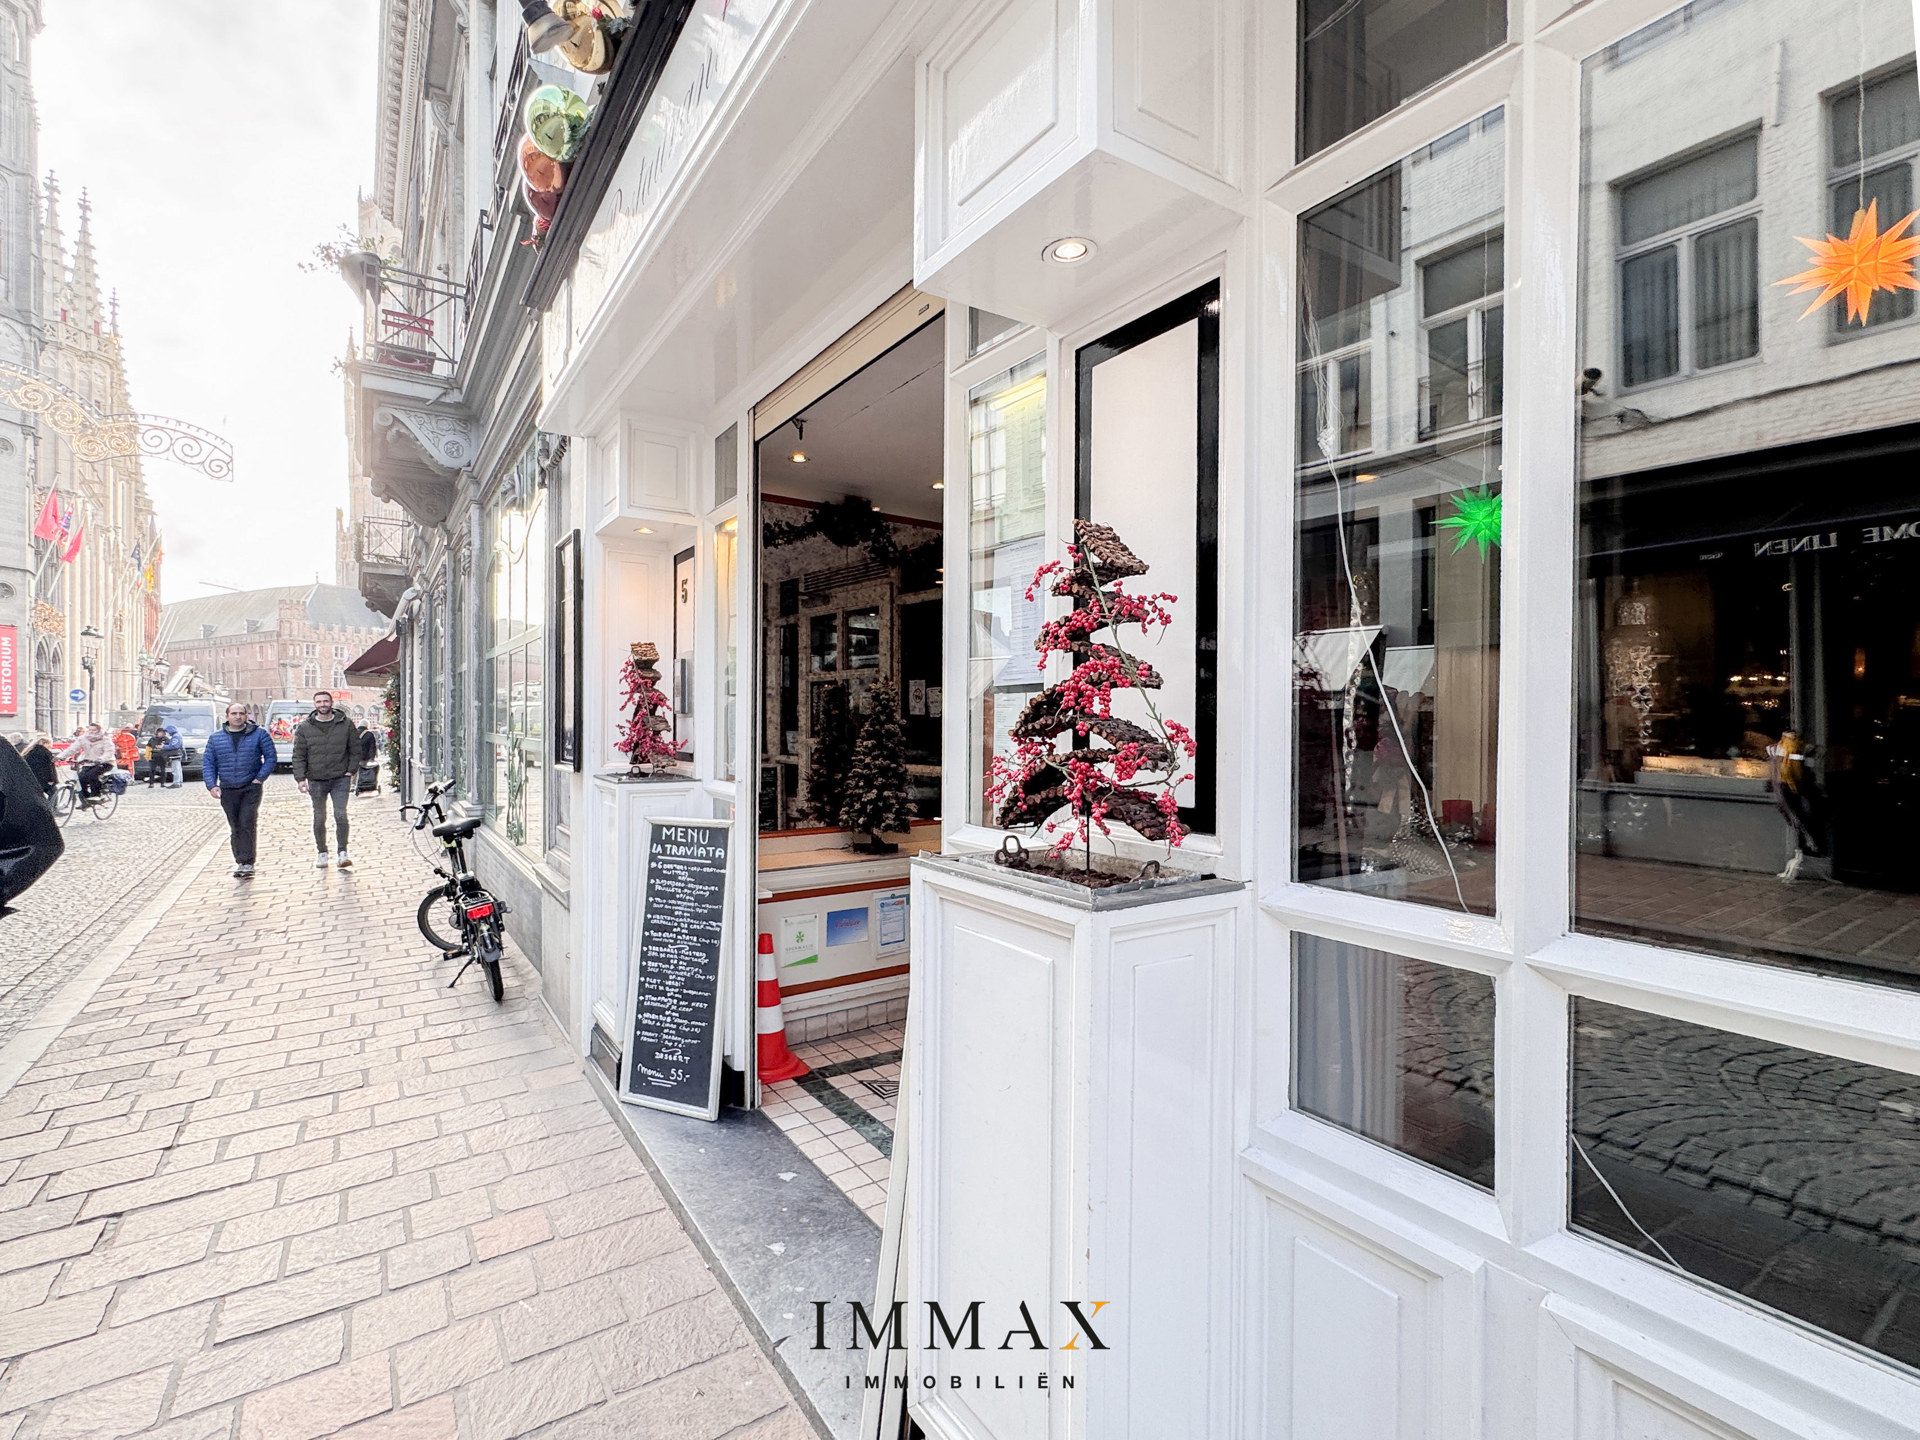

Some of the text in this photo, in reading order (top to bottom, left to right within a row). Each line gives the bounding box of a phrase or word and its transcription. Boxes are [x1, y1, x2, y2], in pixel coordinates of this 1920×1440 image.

[681, 578, 688, 604] 5
[1, 636, 15, 705] HISTORIUM
[661, 826, 710, 845] MENU
[651, 843, 663, 854] LA
